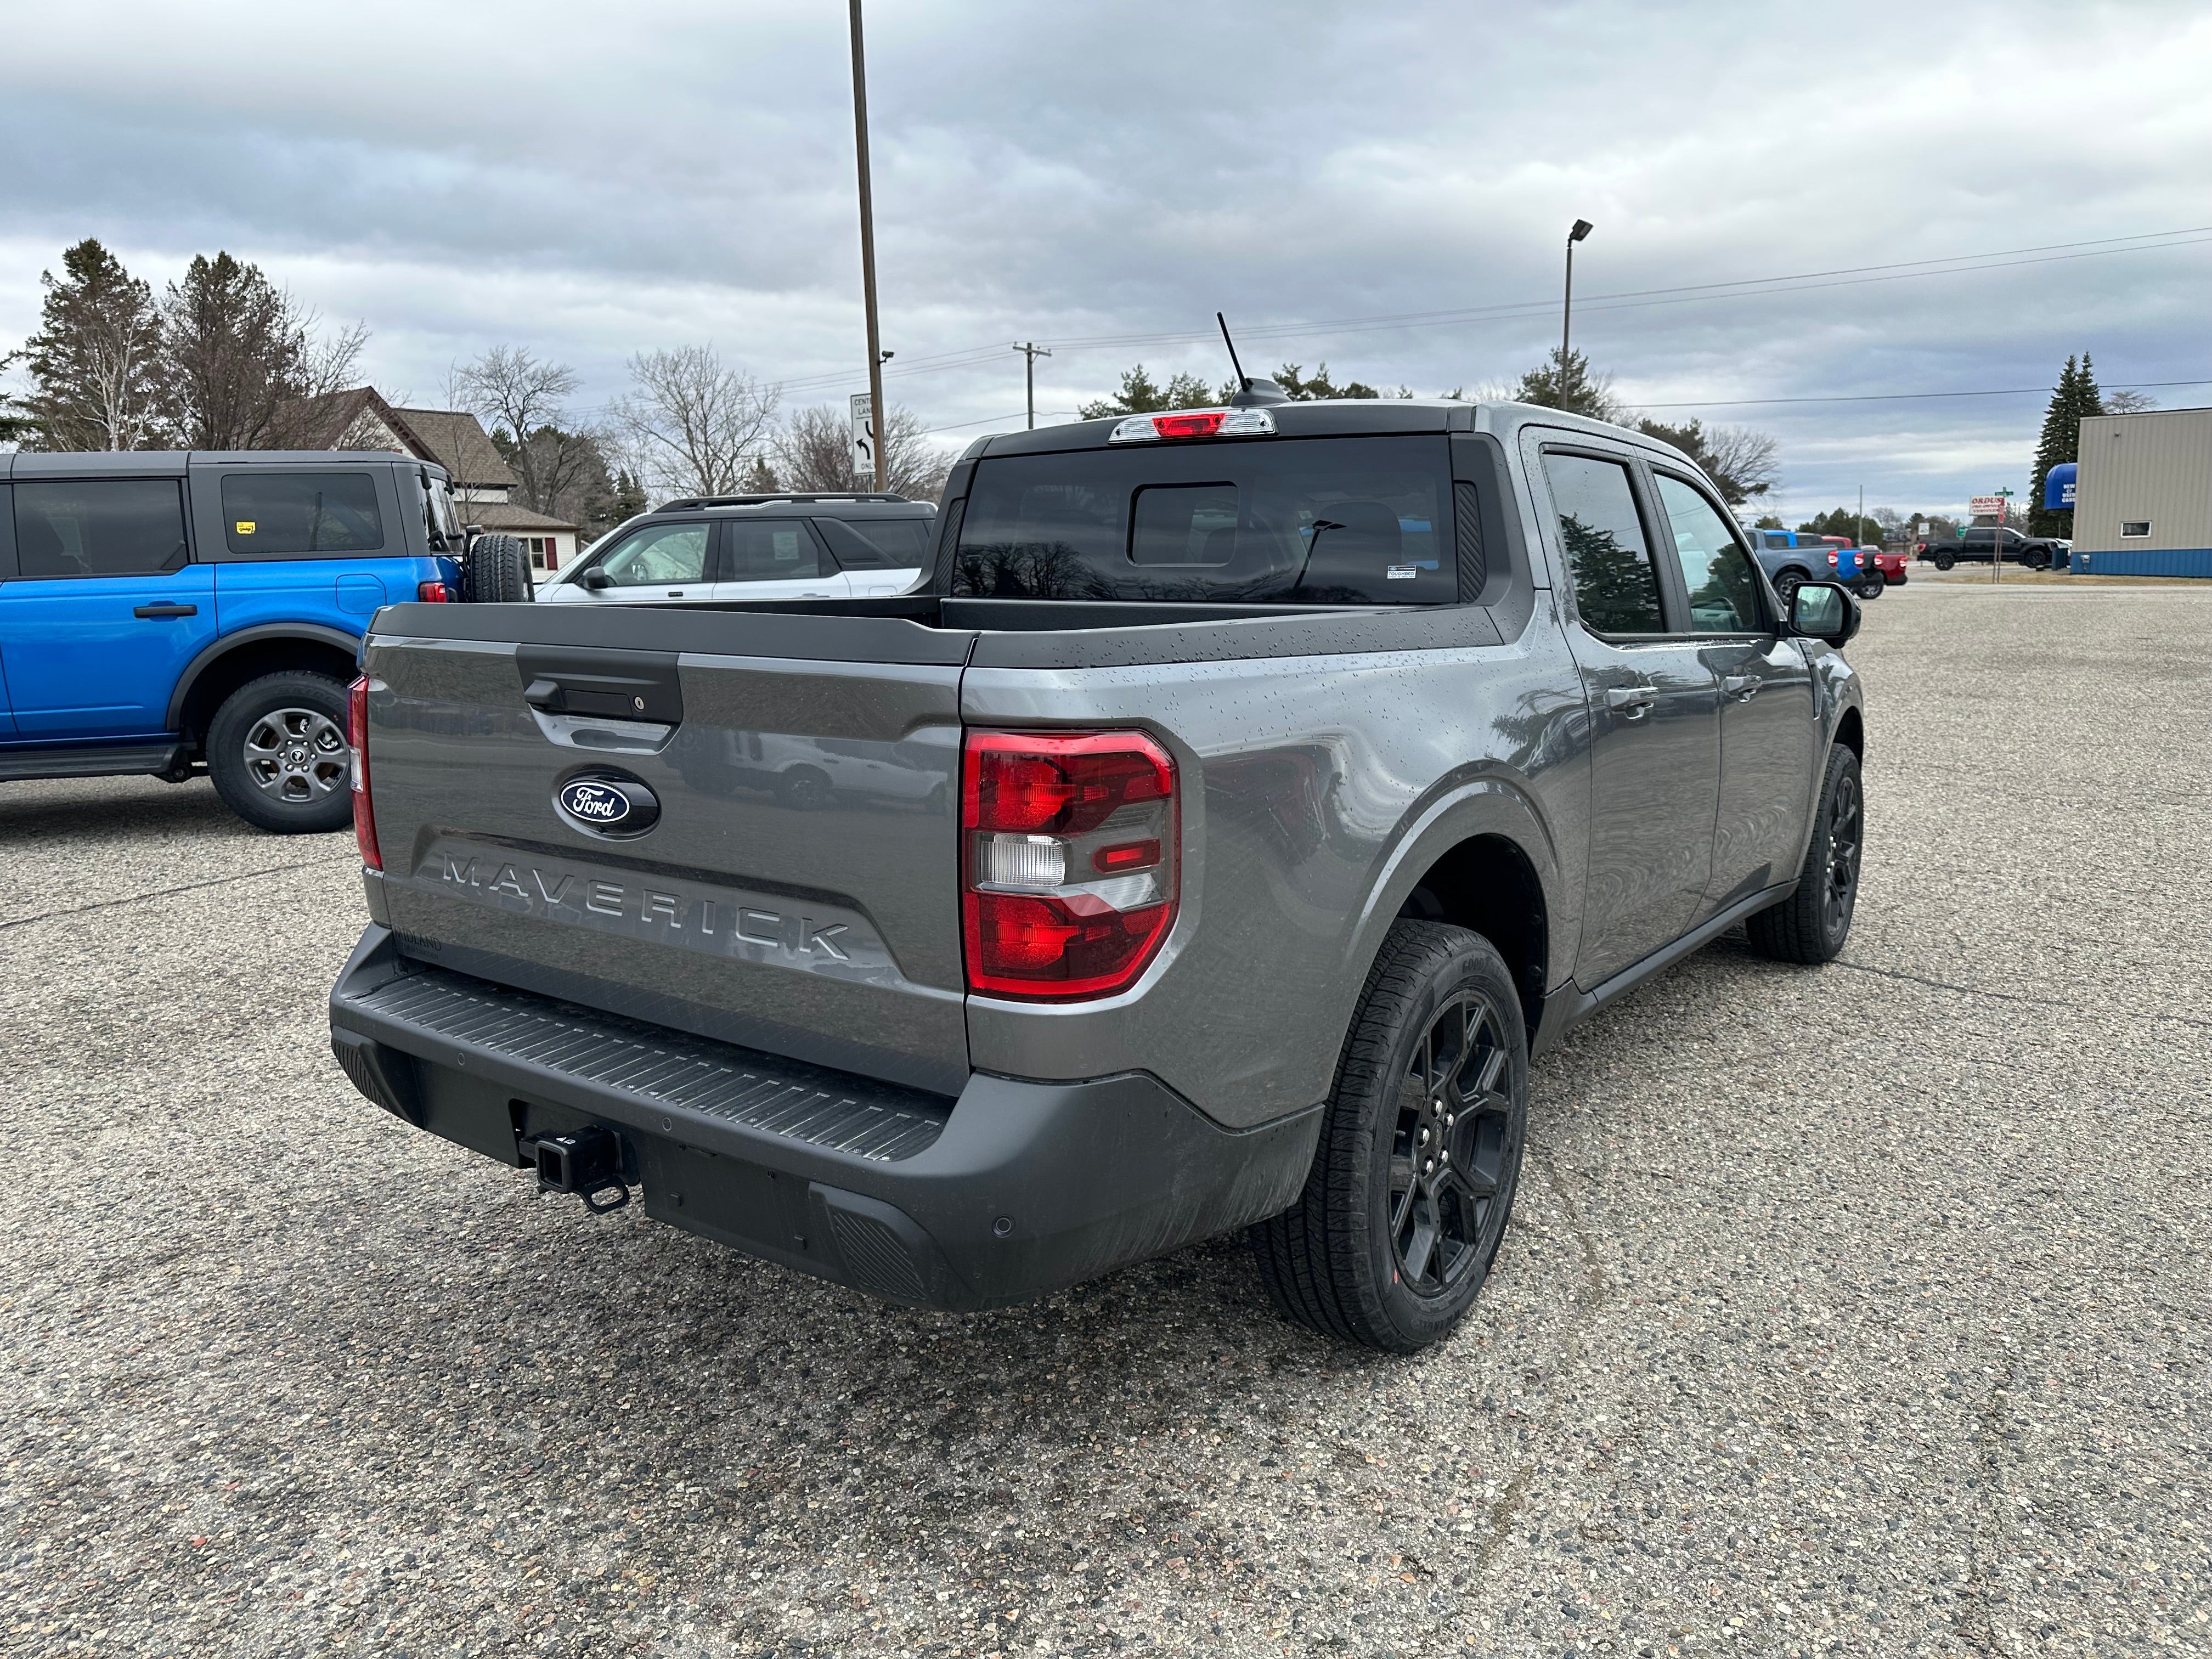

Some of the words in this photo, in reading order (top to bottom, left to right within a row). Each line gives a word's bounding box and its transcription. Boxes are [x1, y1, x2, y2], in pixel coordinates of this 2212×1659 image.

[854, 398, 872, 406] CENT
[572, 786, 615, 817] Ford
[442, 851, 851, 962] MAVERICK
[394, 926, 442, 951] MIDLAND
